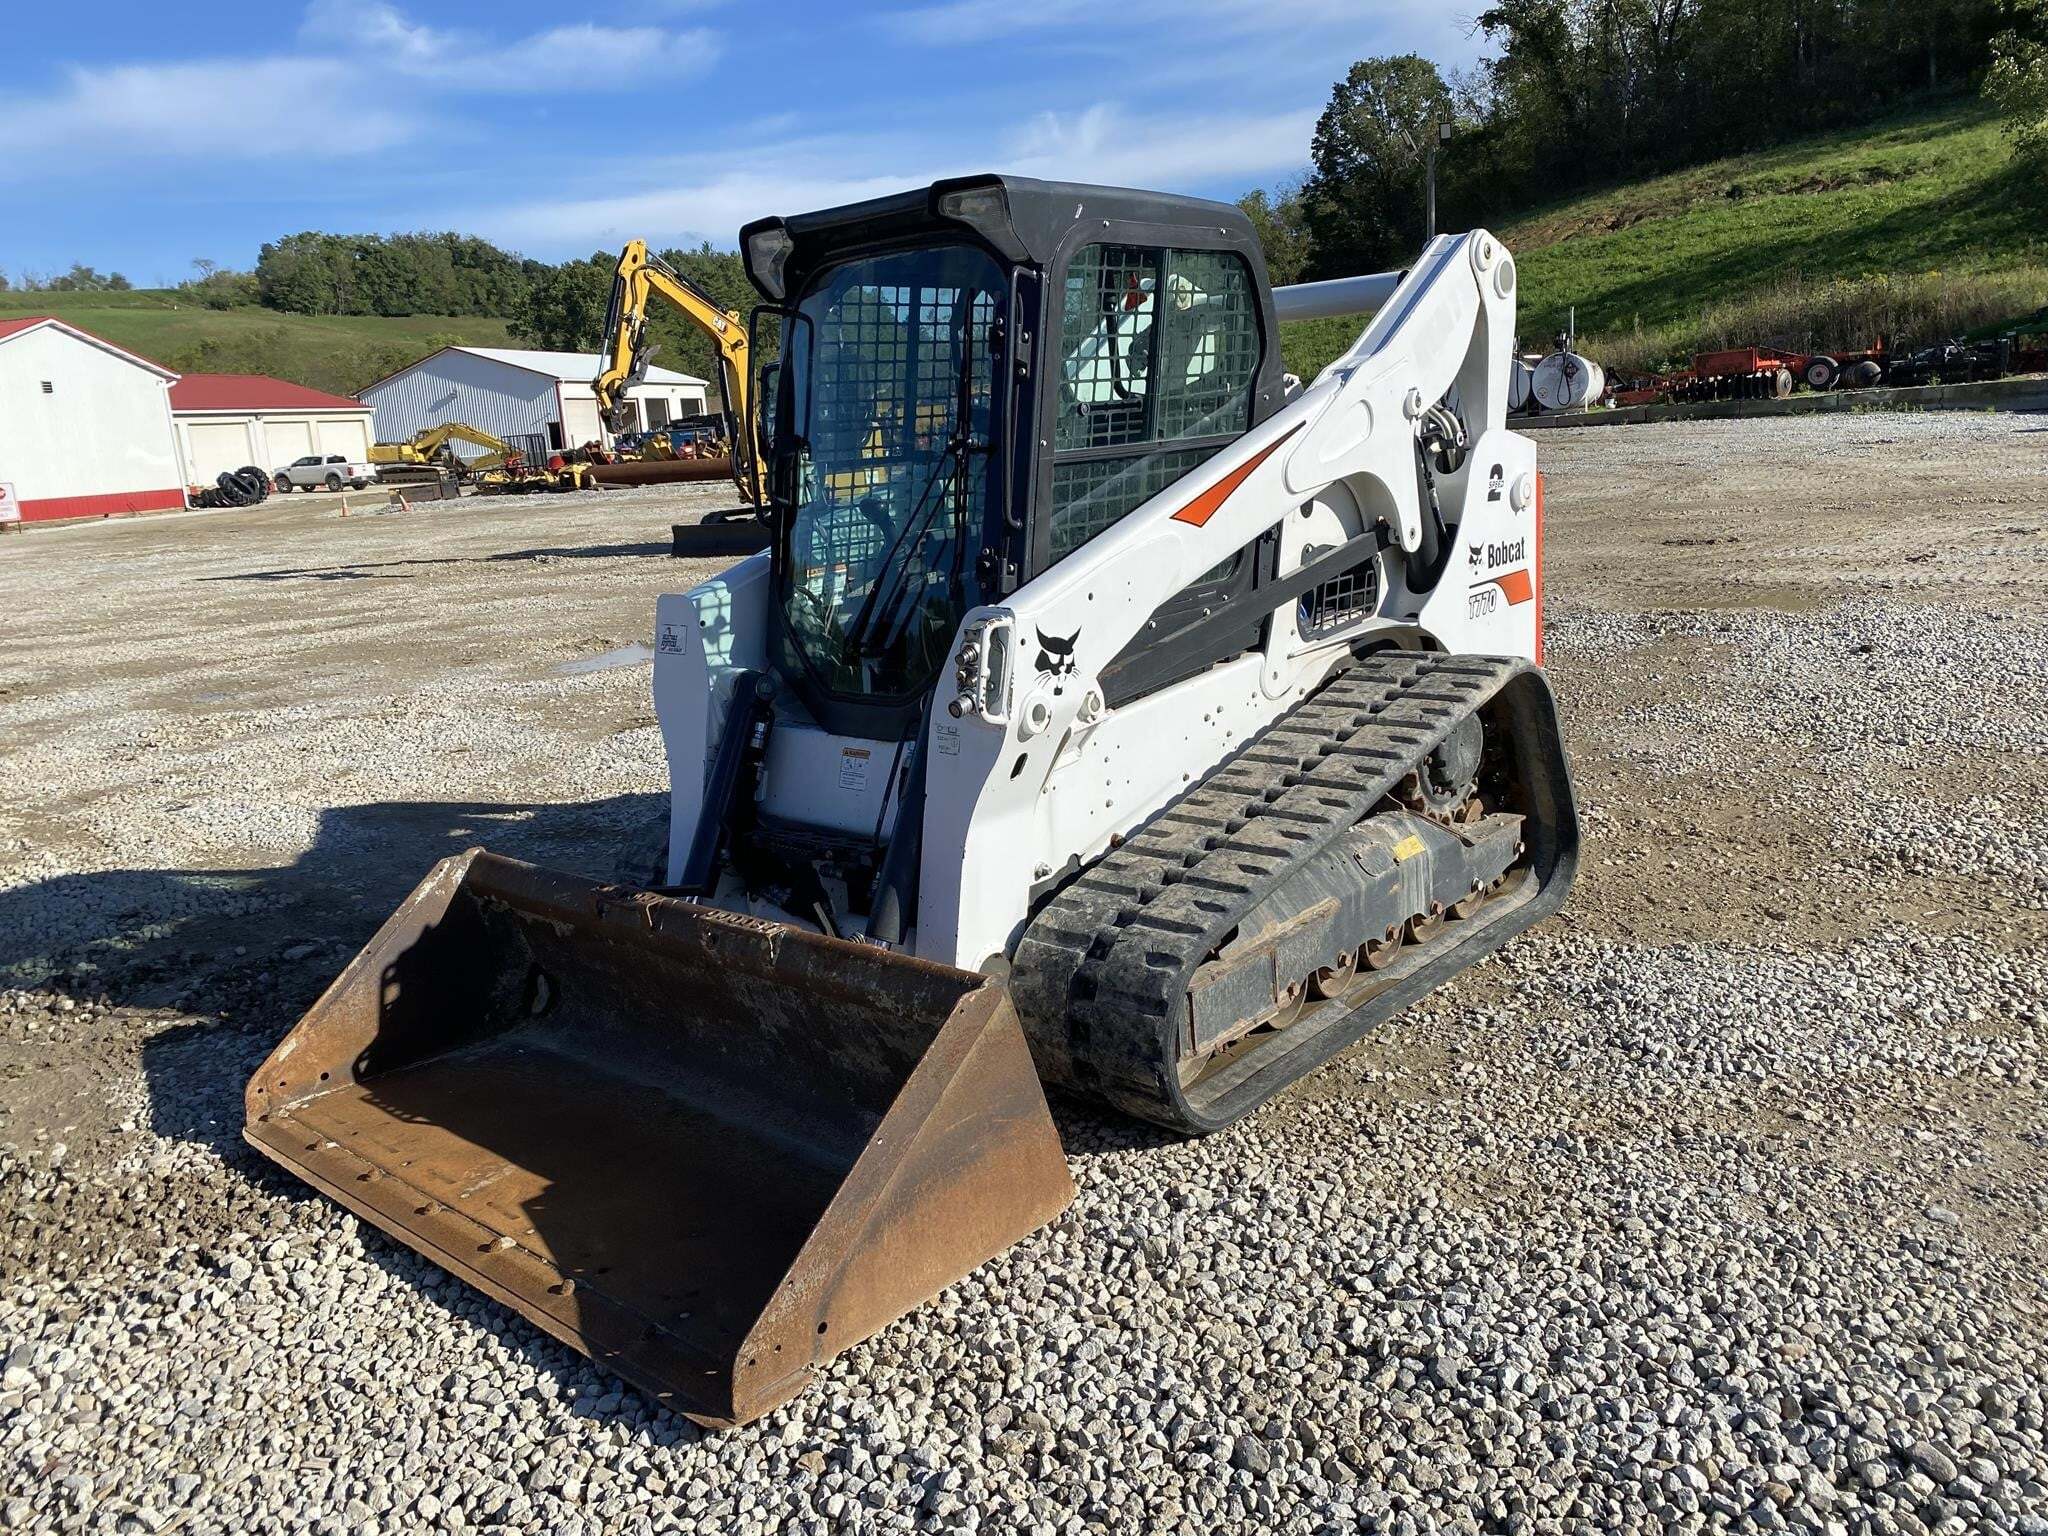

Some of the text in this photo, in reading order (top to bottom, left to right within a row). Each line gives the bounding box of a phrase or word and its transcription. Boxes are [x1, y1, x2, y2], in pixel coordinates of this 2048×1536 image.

[1487, 463, 1503, 502] 2
[1488, 537, 1525, 568] Bobcat
[1468, 588, 1497, 619] T770
